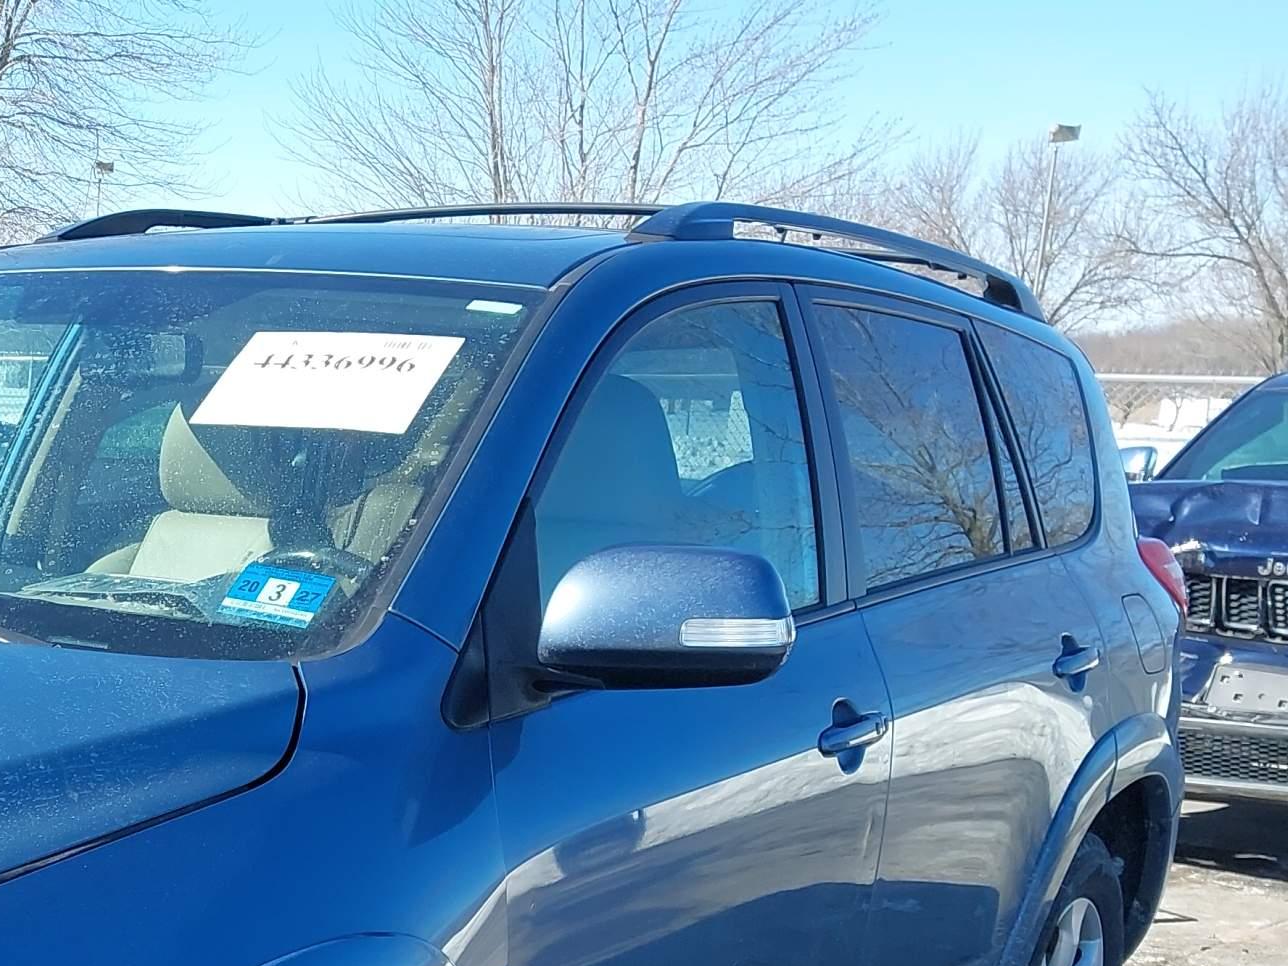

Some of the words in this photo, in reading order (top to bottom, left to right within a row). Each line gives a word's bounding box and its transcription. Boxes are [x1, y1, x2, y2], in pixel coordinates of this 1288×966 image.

[254, 353, 416, 373] 44336996
[238, 579, 260, 593] 20
[269, 583, 286, 601] 3
[297, 591, 321, 604] 27
